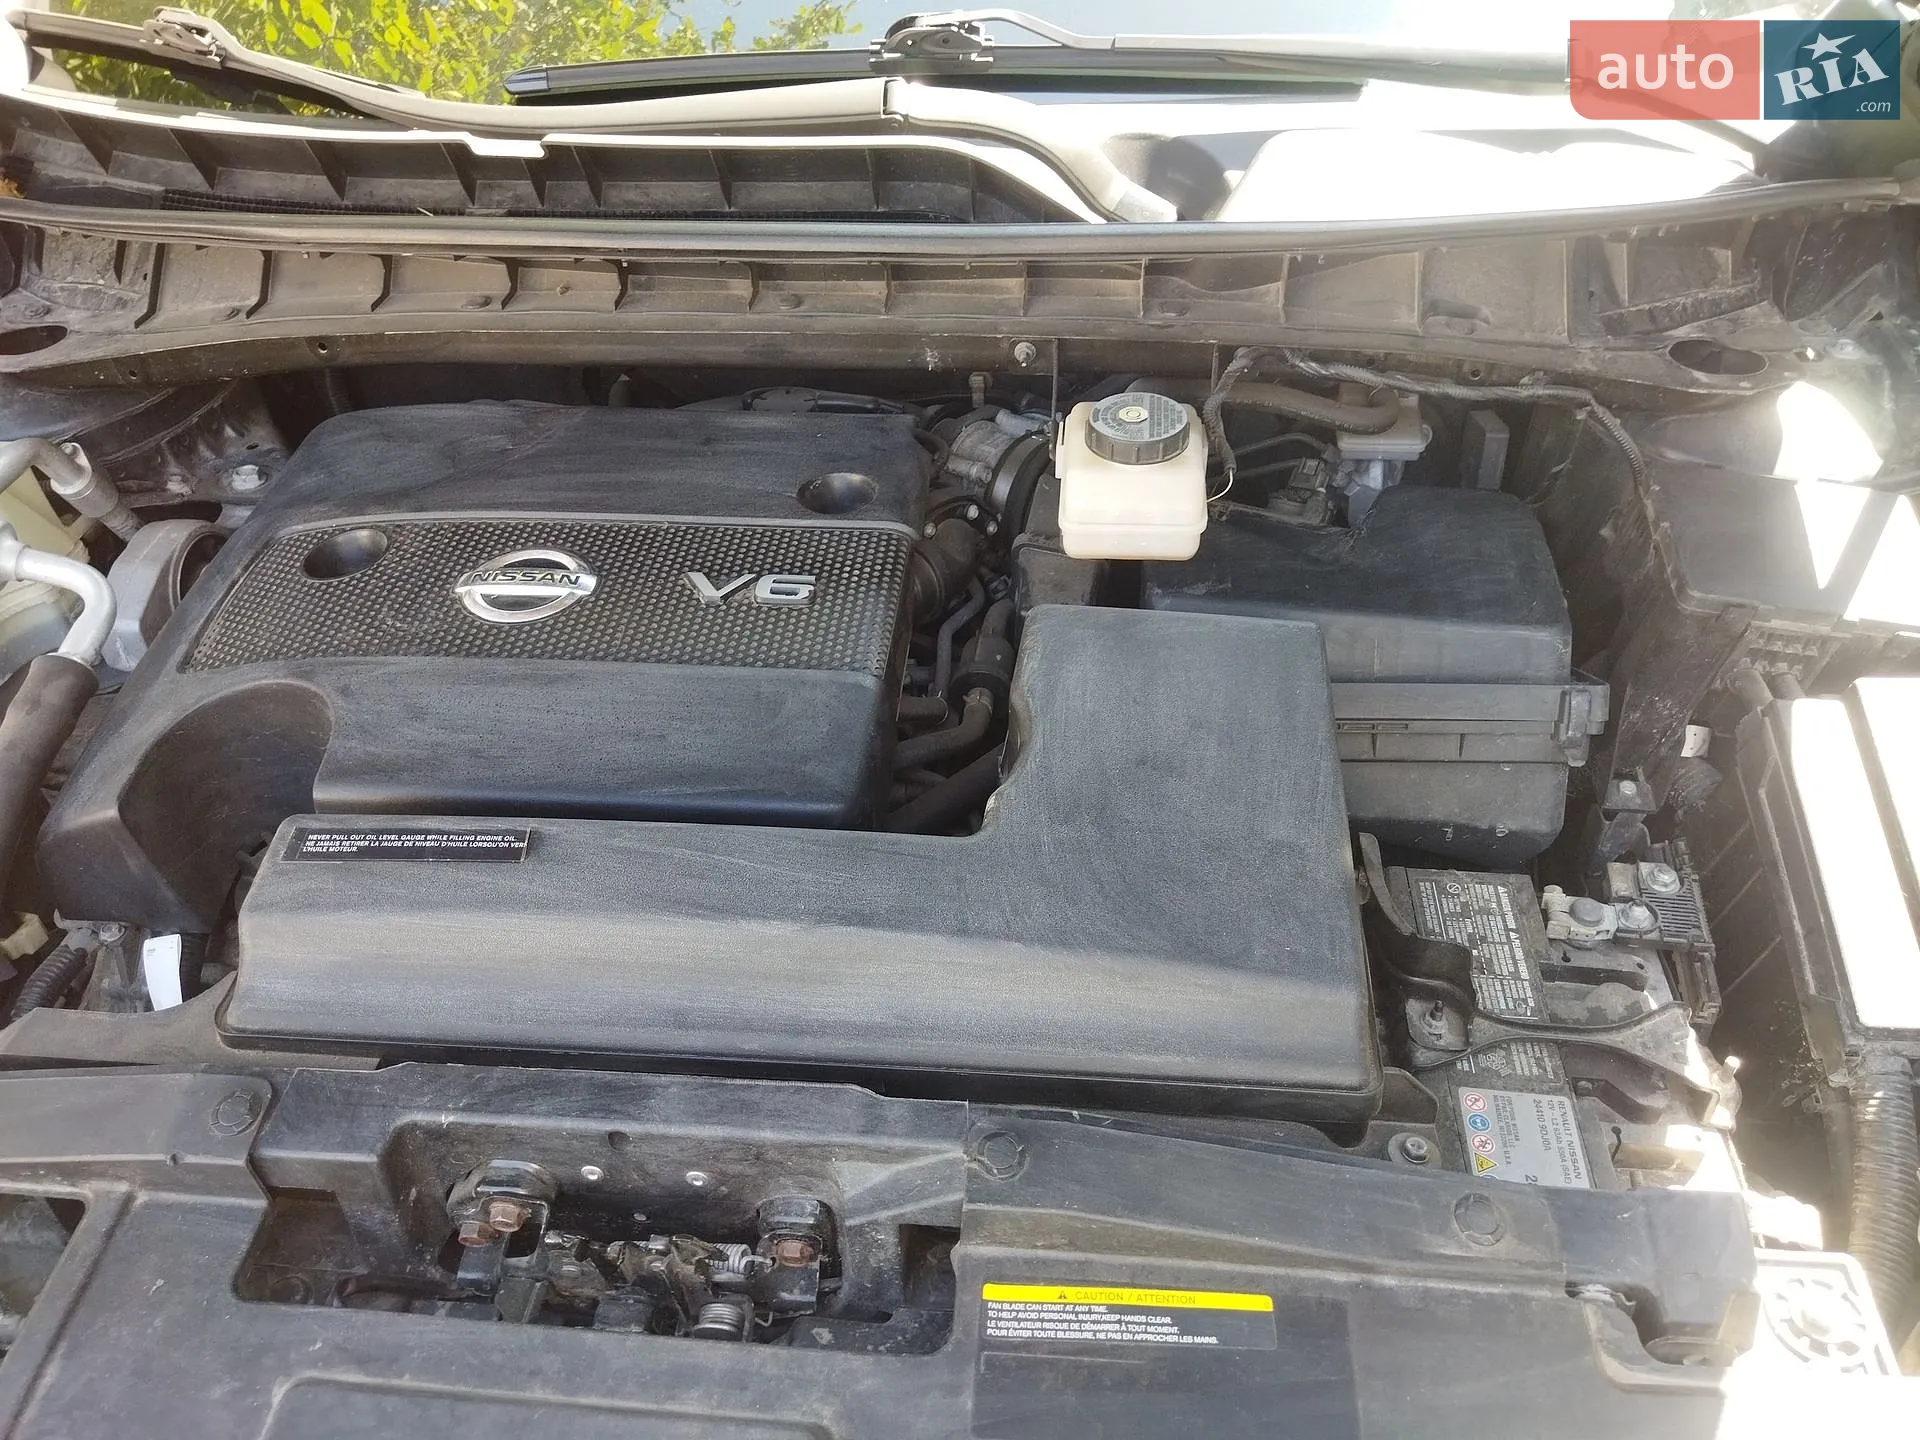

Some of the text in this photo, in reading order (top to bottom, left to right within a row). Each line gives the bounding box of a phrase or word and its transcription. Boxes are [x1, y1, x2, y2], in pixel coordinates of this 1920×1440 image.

[469, 570, 581, 585] NISSAN
[684, 571, 817, 607] V6
[1533, 1098, 1545, 1123] 24410
[1558, 1100, 1582, 1180] RENAULT NISSAN
[1075, 1291, 1124, 1301] CAUTION
[1136, 1294, 1196, 1304] ATTENTION
[987, 1302, 1002, 1310] FAN
[1002, 1302, 1025, 1310] BLADE
[1026, 1303, 1042, 1311] CAN
[1042, 1303, 1065, 1311] START
[1075, 1304, 1090, 1312] ANY
[987, 1310, 998, 1318] TO
[998, 1311, 1017, 1319] HELP
[1017, 1311, 1039, 1319] AVOID
[1040, 1312, 1078, 1320] PERSONAL
[1121, 1315, 1147, 1323] HANDS
[997, 1320, 1042, 1329] VENTILATEUR
[1042, 1322, 1069, 1330] RISQUE
[1081, 1321, 1120, 1331] DÉMARRER
[1120, 1322, 1127, 1331] À
[1127, 1324, 1146, 1332] TOUT
[986, 1329, 1008, 1337] POUR
[1008, 1328, 1033, 1337] ÉVITER
[1033, 1330, 1056, 1338] TOUTE
[1107, 1332, 1122, 1340] PAS
[1133, 1333, 1178, 1342] APPROCHER
[1179, 1335, 1193, 1343] LES
